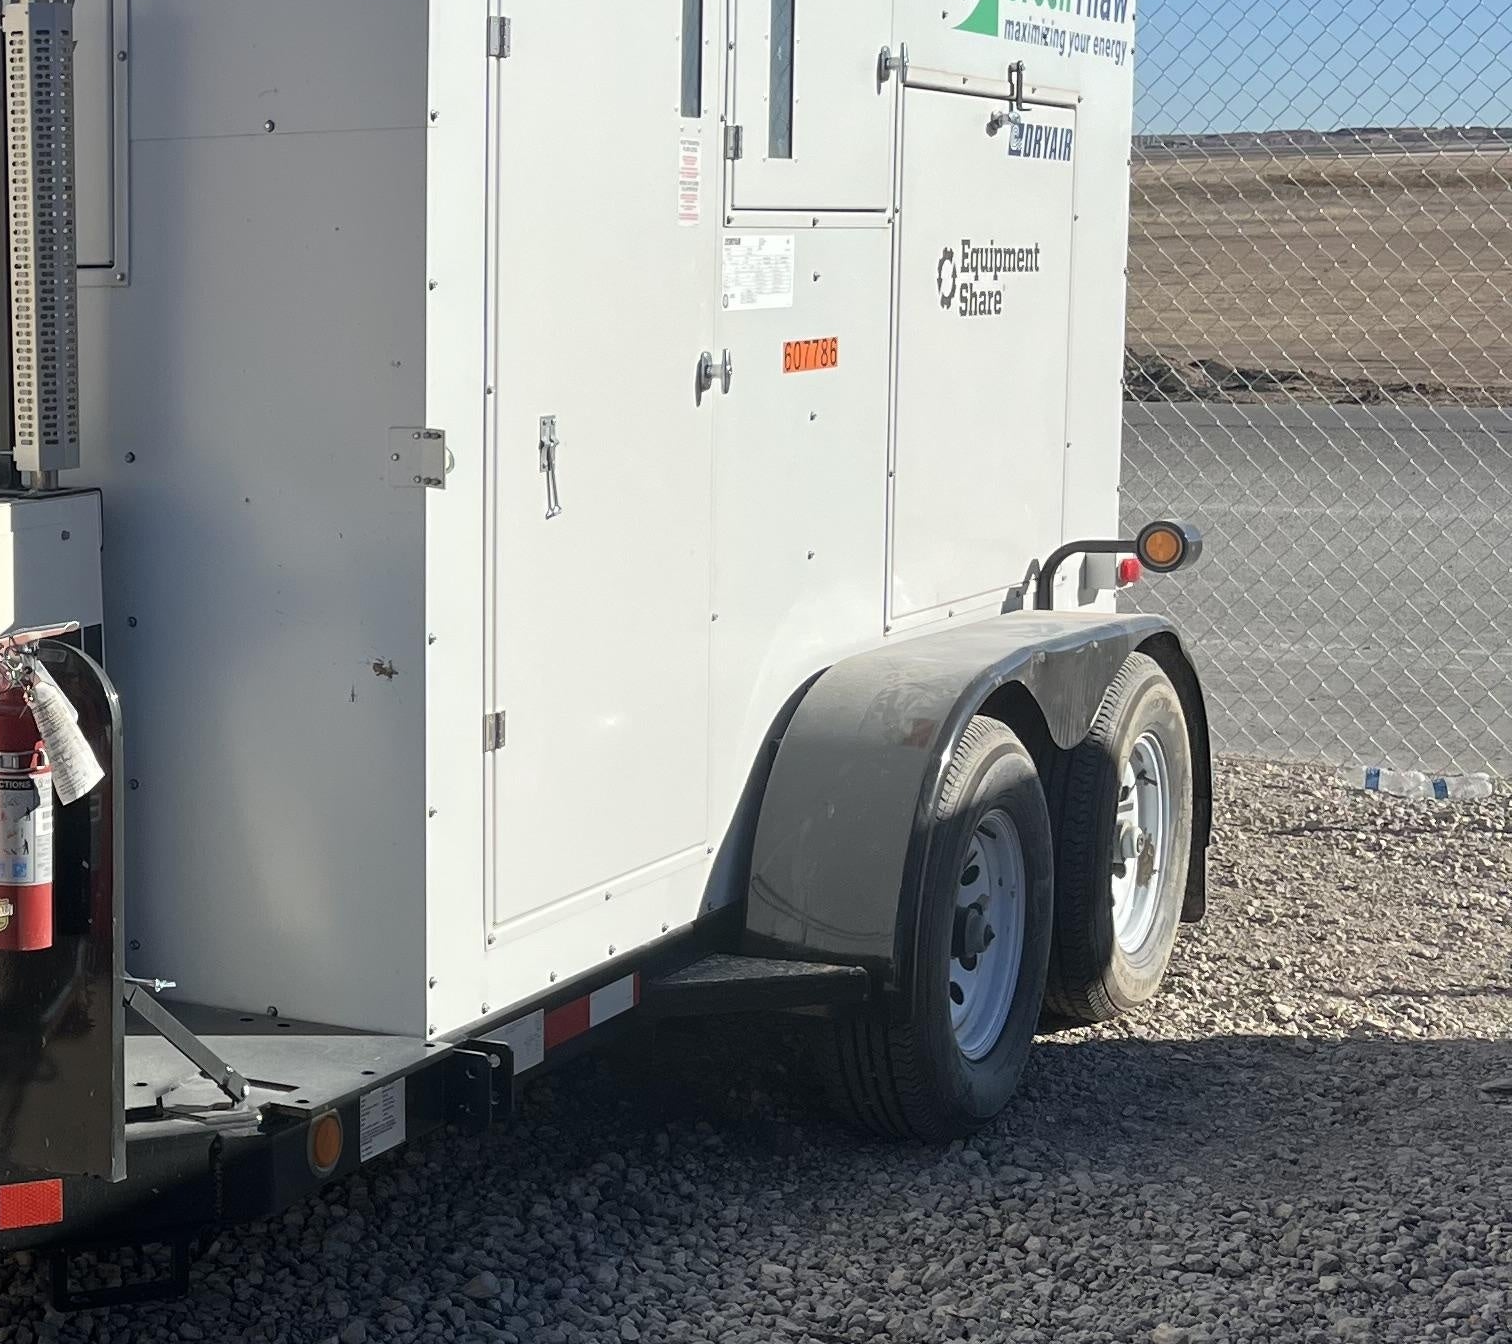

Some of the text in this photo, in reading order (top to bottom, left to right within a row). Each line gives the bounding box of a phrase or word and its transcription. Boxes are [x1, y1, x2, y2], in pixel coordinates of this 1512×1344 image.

[1003, 16, 1128, 66] maximizing your energy
[1021, 122, 1074, 162] DRYAIR
[960, 239, 1041, 282] Equipment
[958, 282, 1003, 317] Share
[784, 337, 838, 372] 607786
